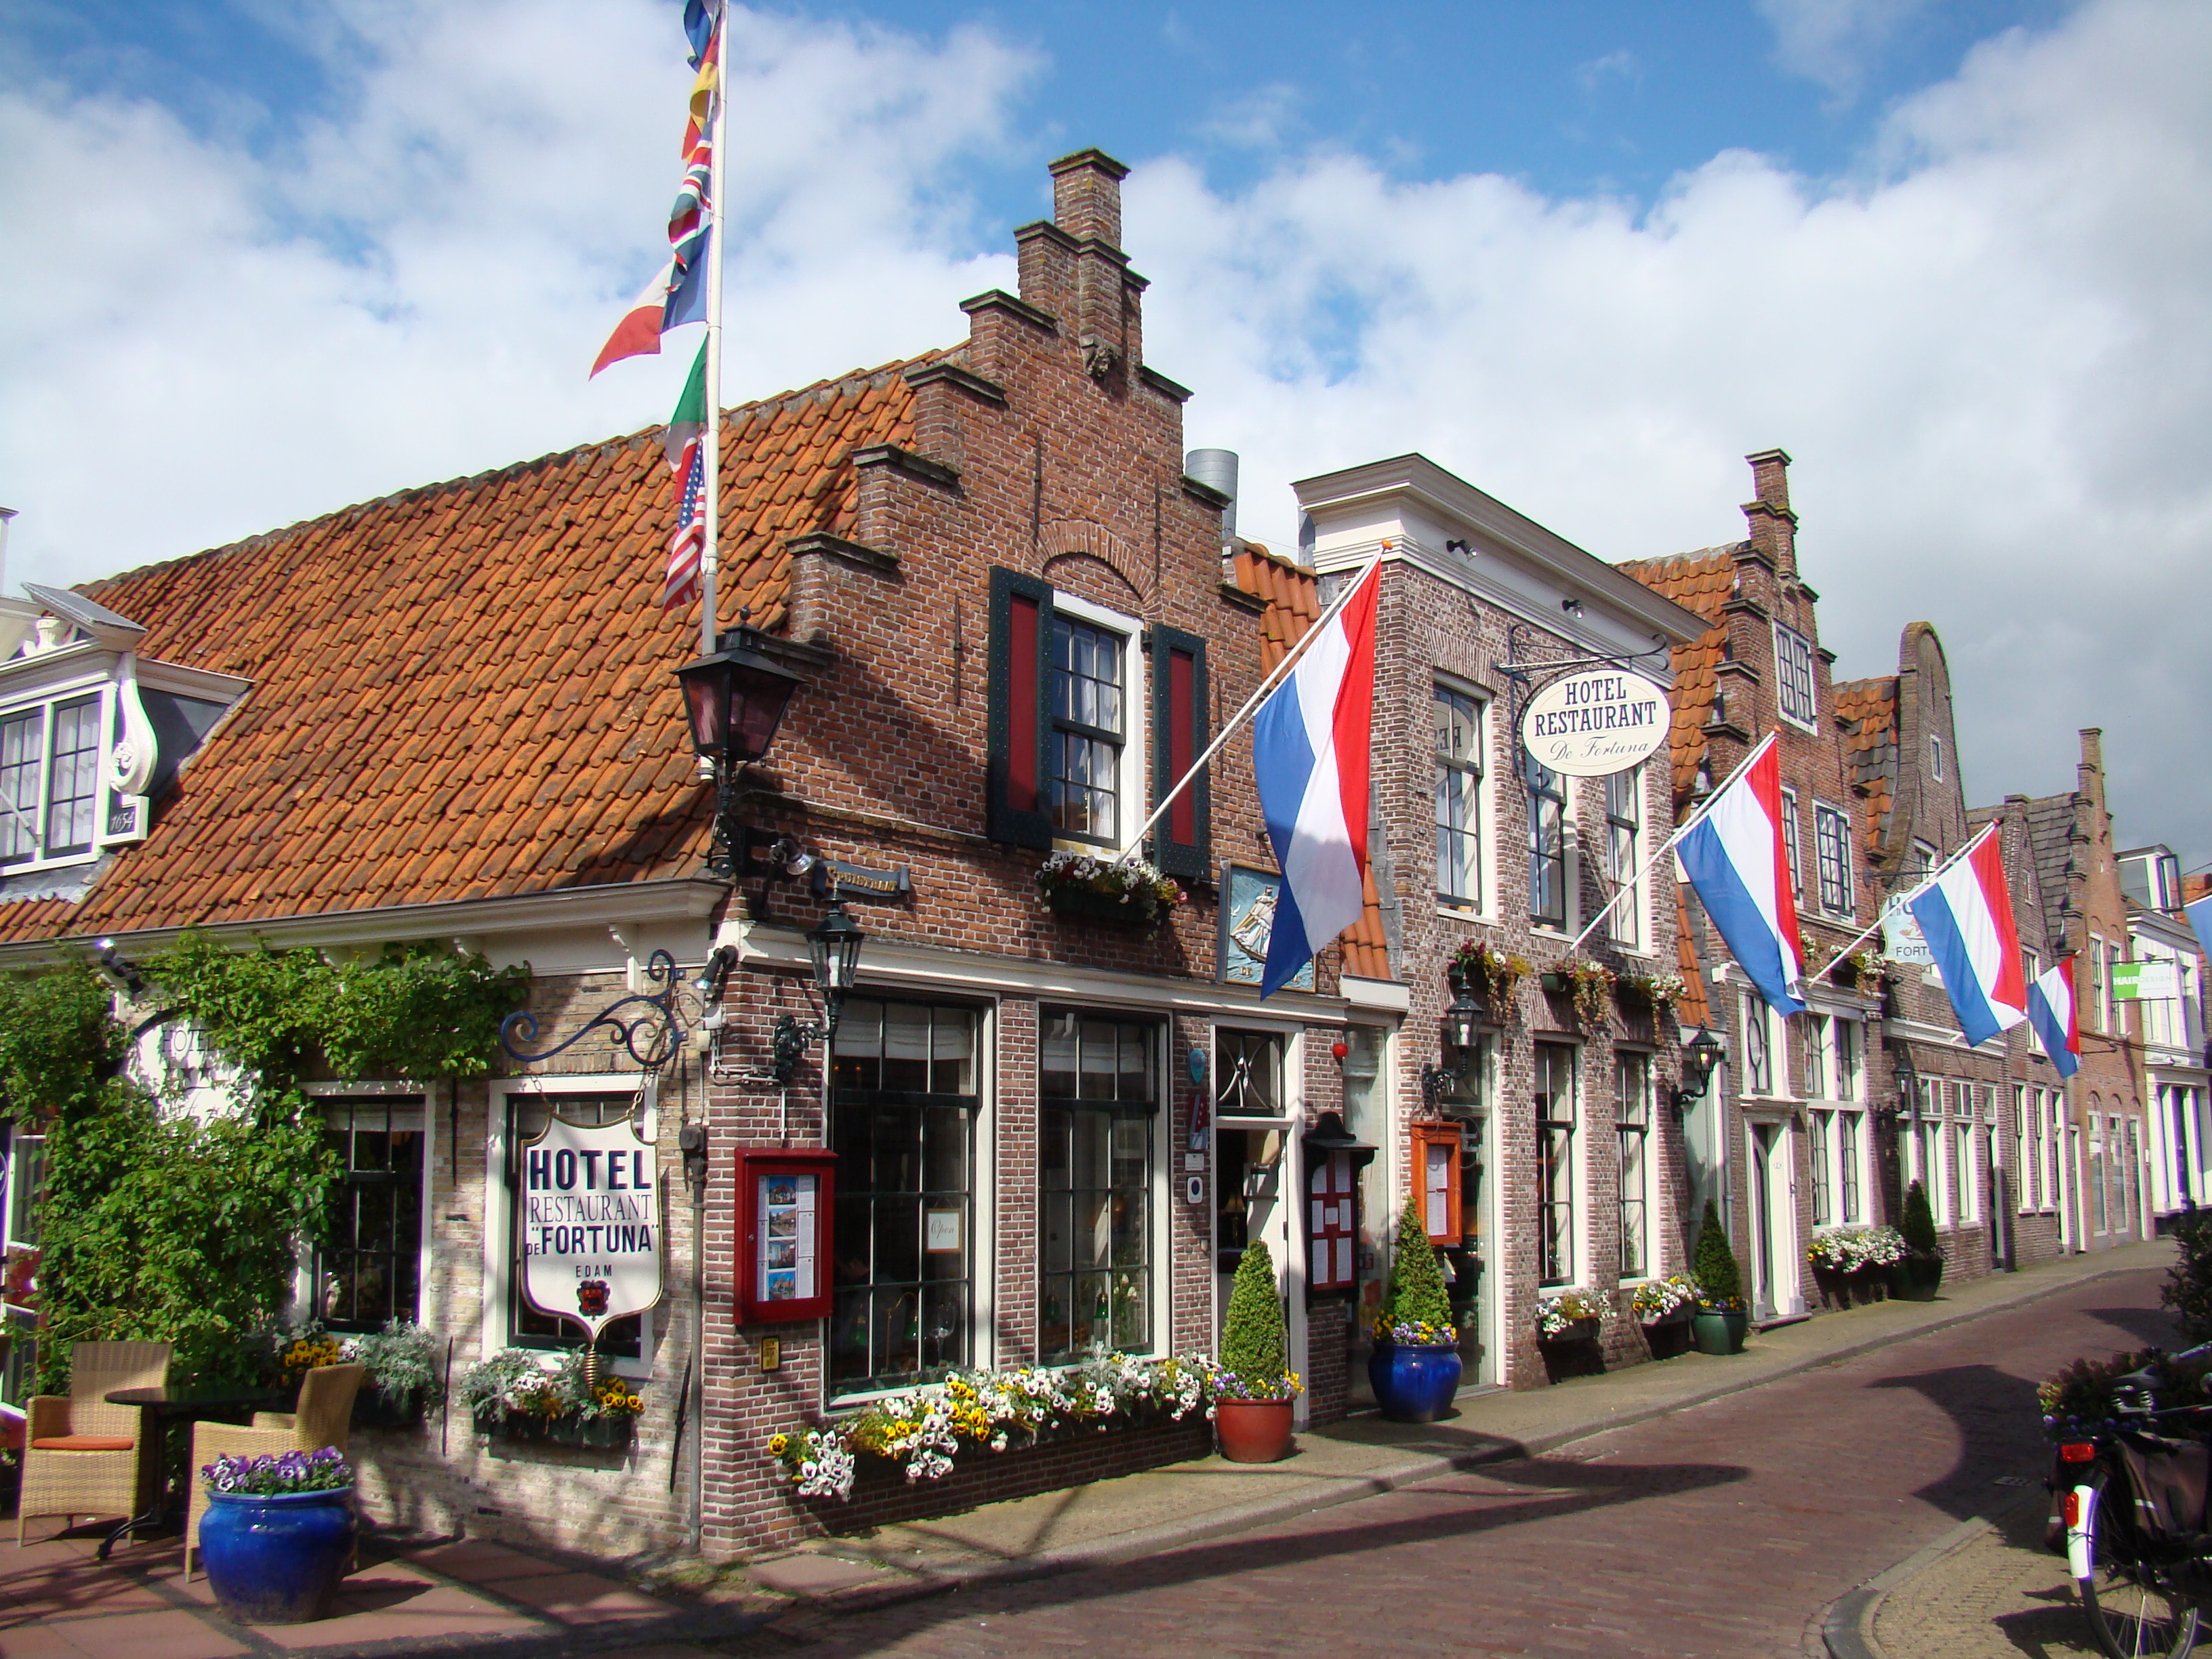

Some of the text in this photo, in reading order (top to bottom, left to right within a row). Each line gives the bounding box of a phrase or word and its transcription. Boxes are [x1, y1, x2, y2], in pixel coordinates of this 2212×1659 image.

[1565, 677, 1626, 705] HOTEL
[1534, 701, 1656, 737] RESTAURANT
[1550, 735, 1650, 762] De Fortuna
[110, 811, 134, 832] 1654
[1896, 946, 1930, 956] FORT
[529, 1149, 652, 1191] HOTEL
[530, 1195, 652, 1223] RESTAURANT
[931, 1218, 954, 1239] Open
[527, 1244, 540, 1256] DE
[575, 1264, 613, 1278] EDAM
